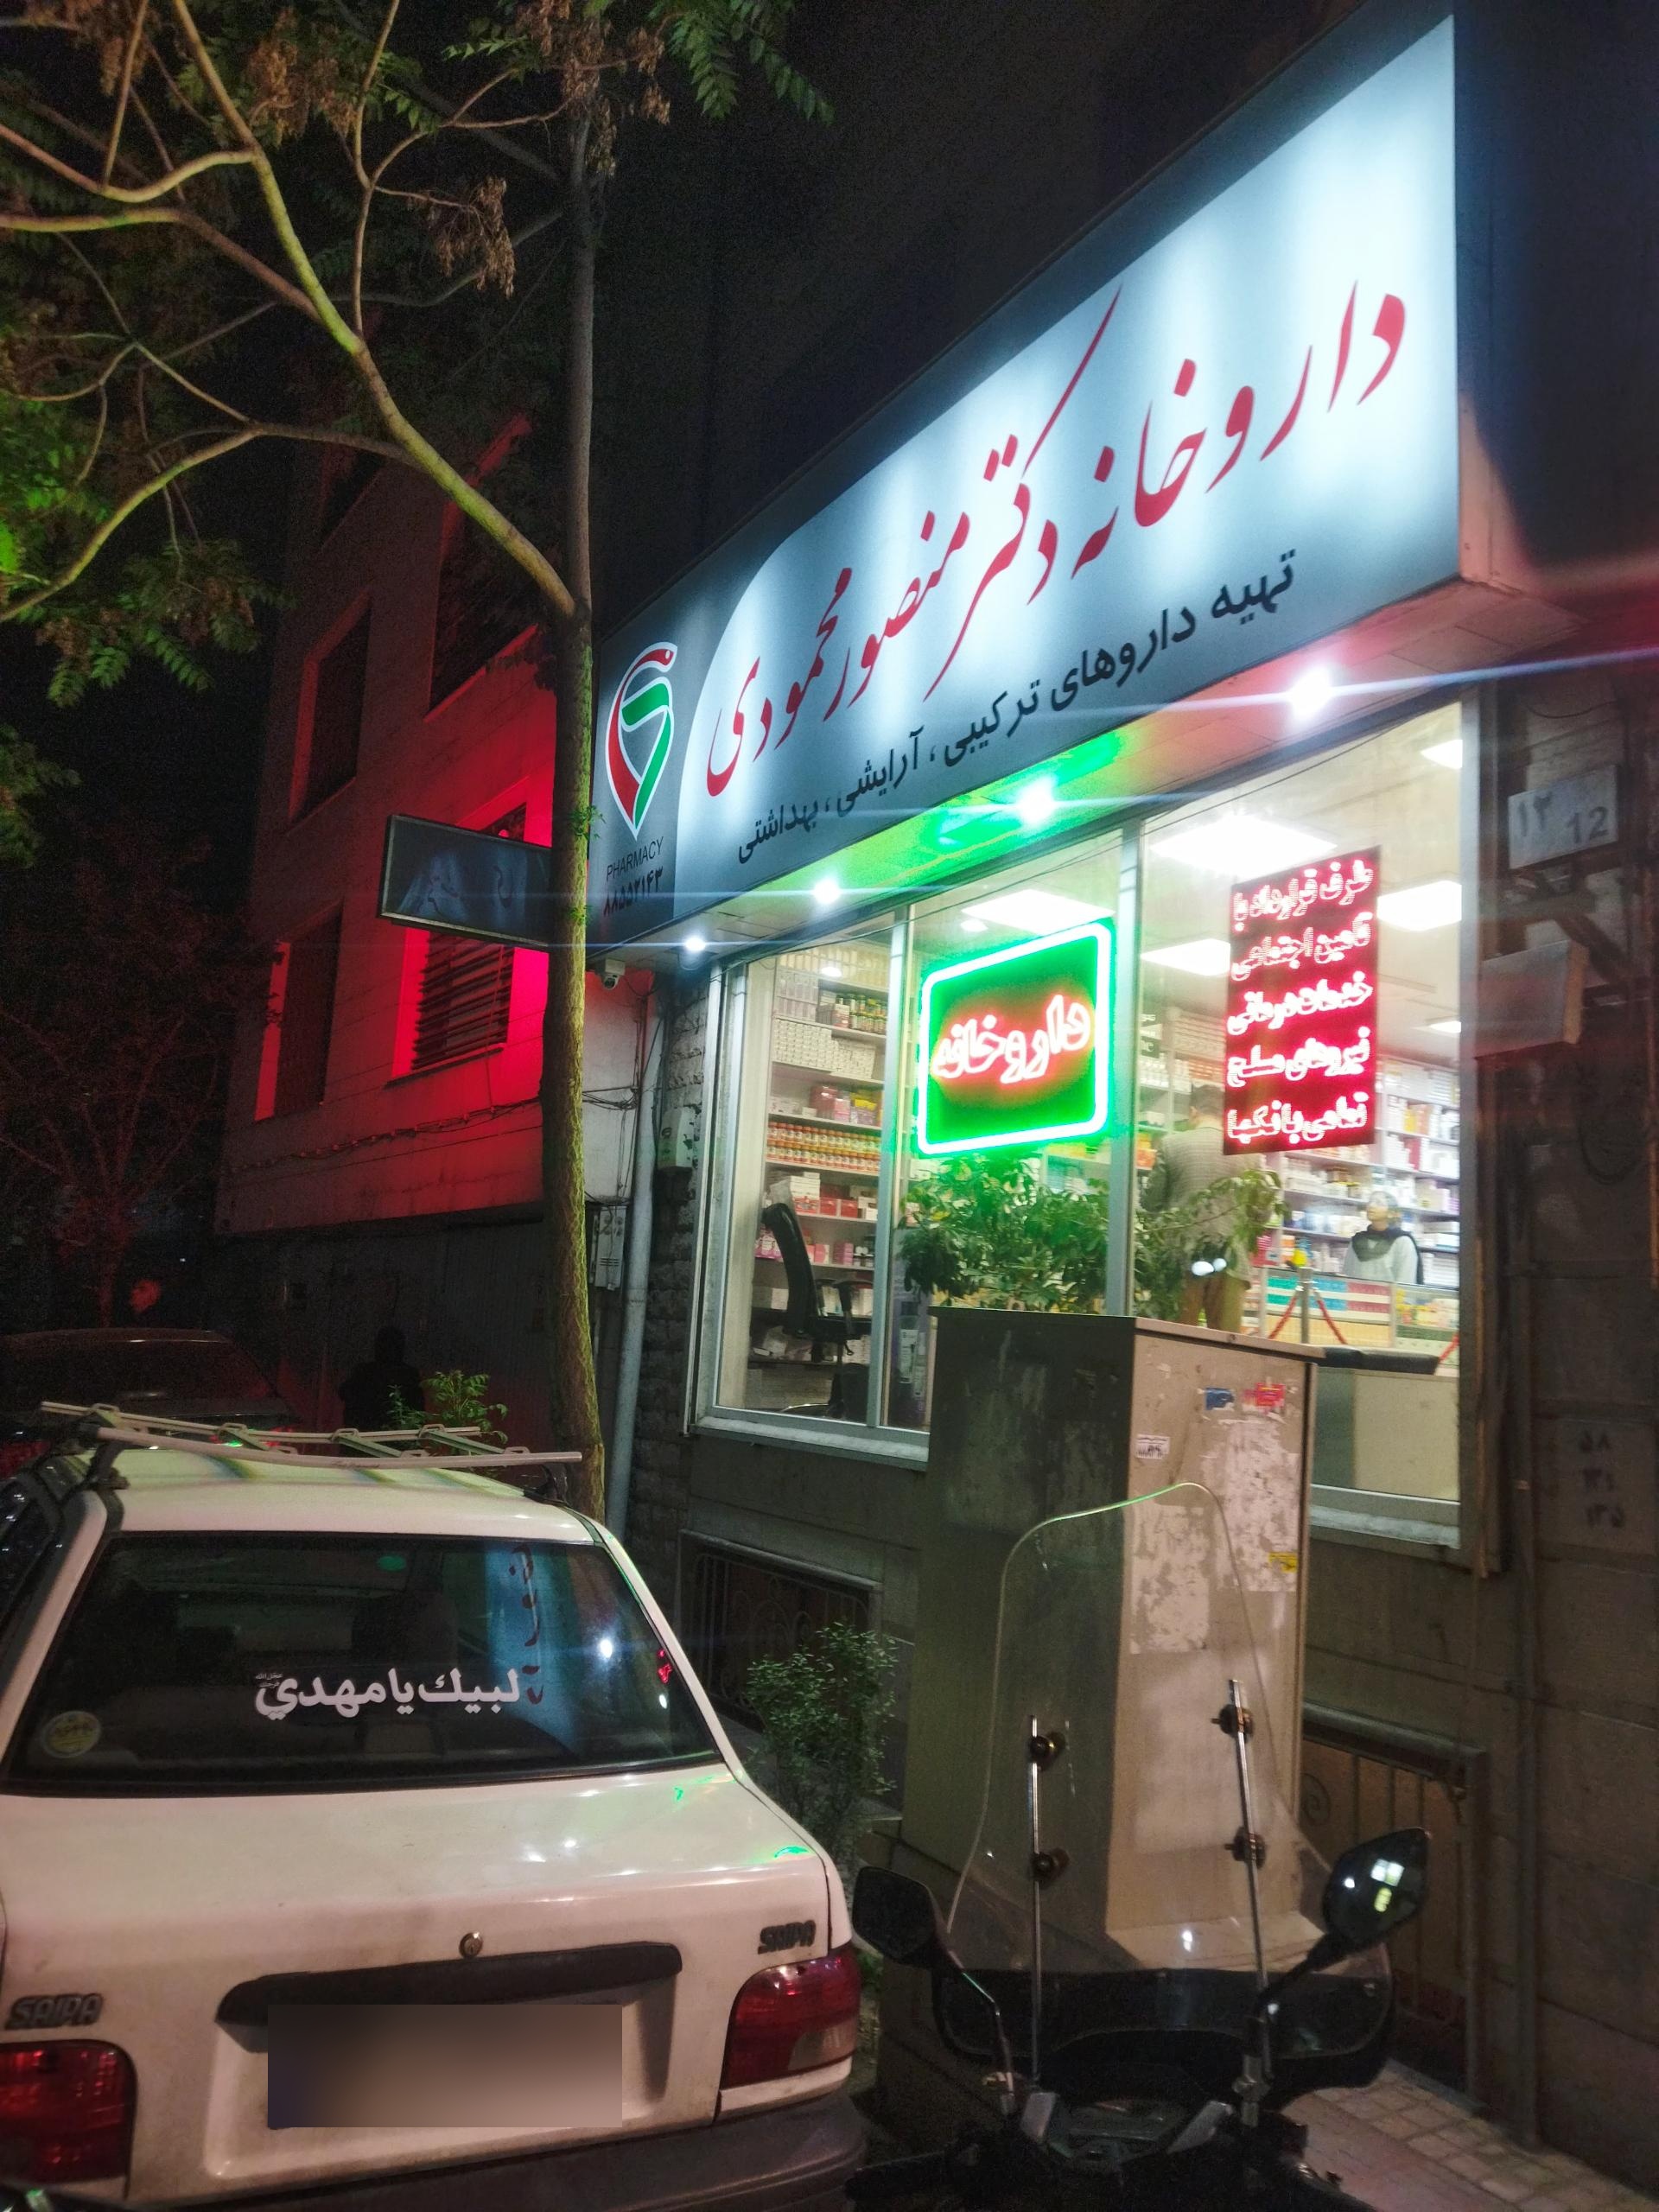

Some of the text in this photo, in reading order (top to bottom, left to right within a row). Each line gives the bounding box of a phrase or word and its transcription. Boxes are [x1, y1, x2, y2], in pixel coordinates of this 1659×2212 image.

[706, 279, 1406, 797] داروخانه دکتر منصور محمودی
[1210, 548, 1297, 625] تهیه
[1052, 608, 1197, 713] داروهای
[738, 801, 819, 864] بهداشتی
[1567, 805, 1610, 844] 12
[606, 836, 664, 881] PHARMACY
[1233, 859, 1375, 932] طرف قرارداد با
[1230, 926, 1314, 982] اجتماعی
[931, 994, 1091, 1085] داروخانه
[1226, 1044, 1286, 1089] مسلح
[3, 1993, 105, 2031] SAIPA
